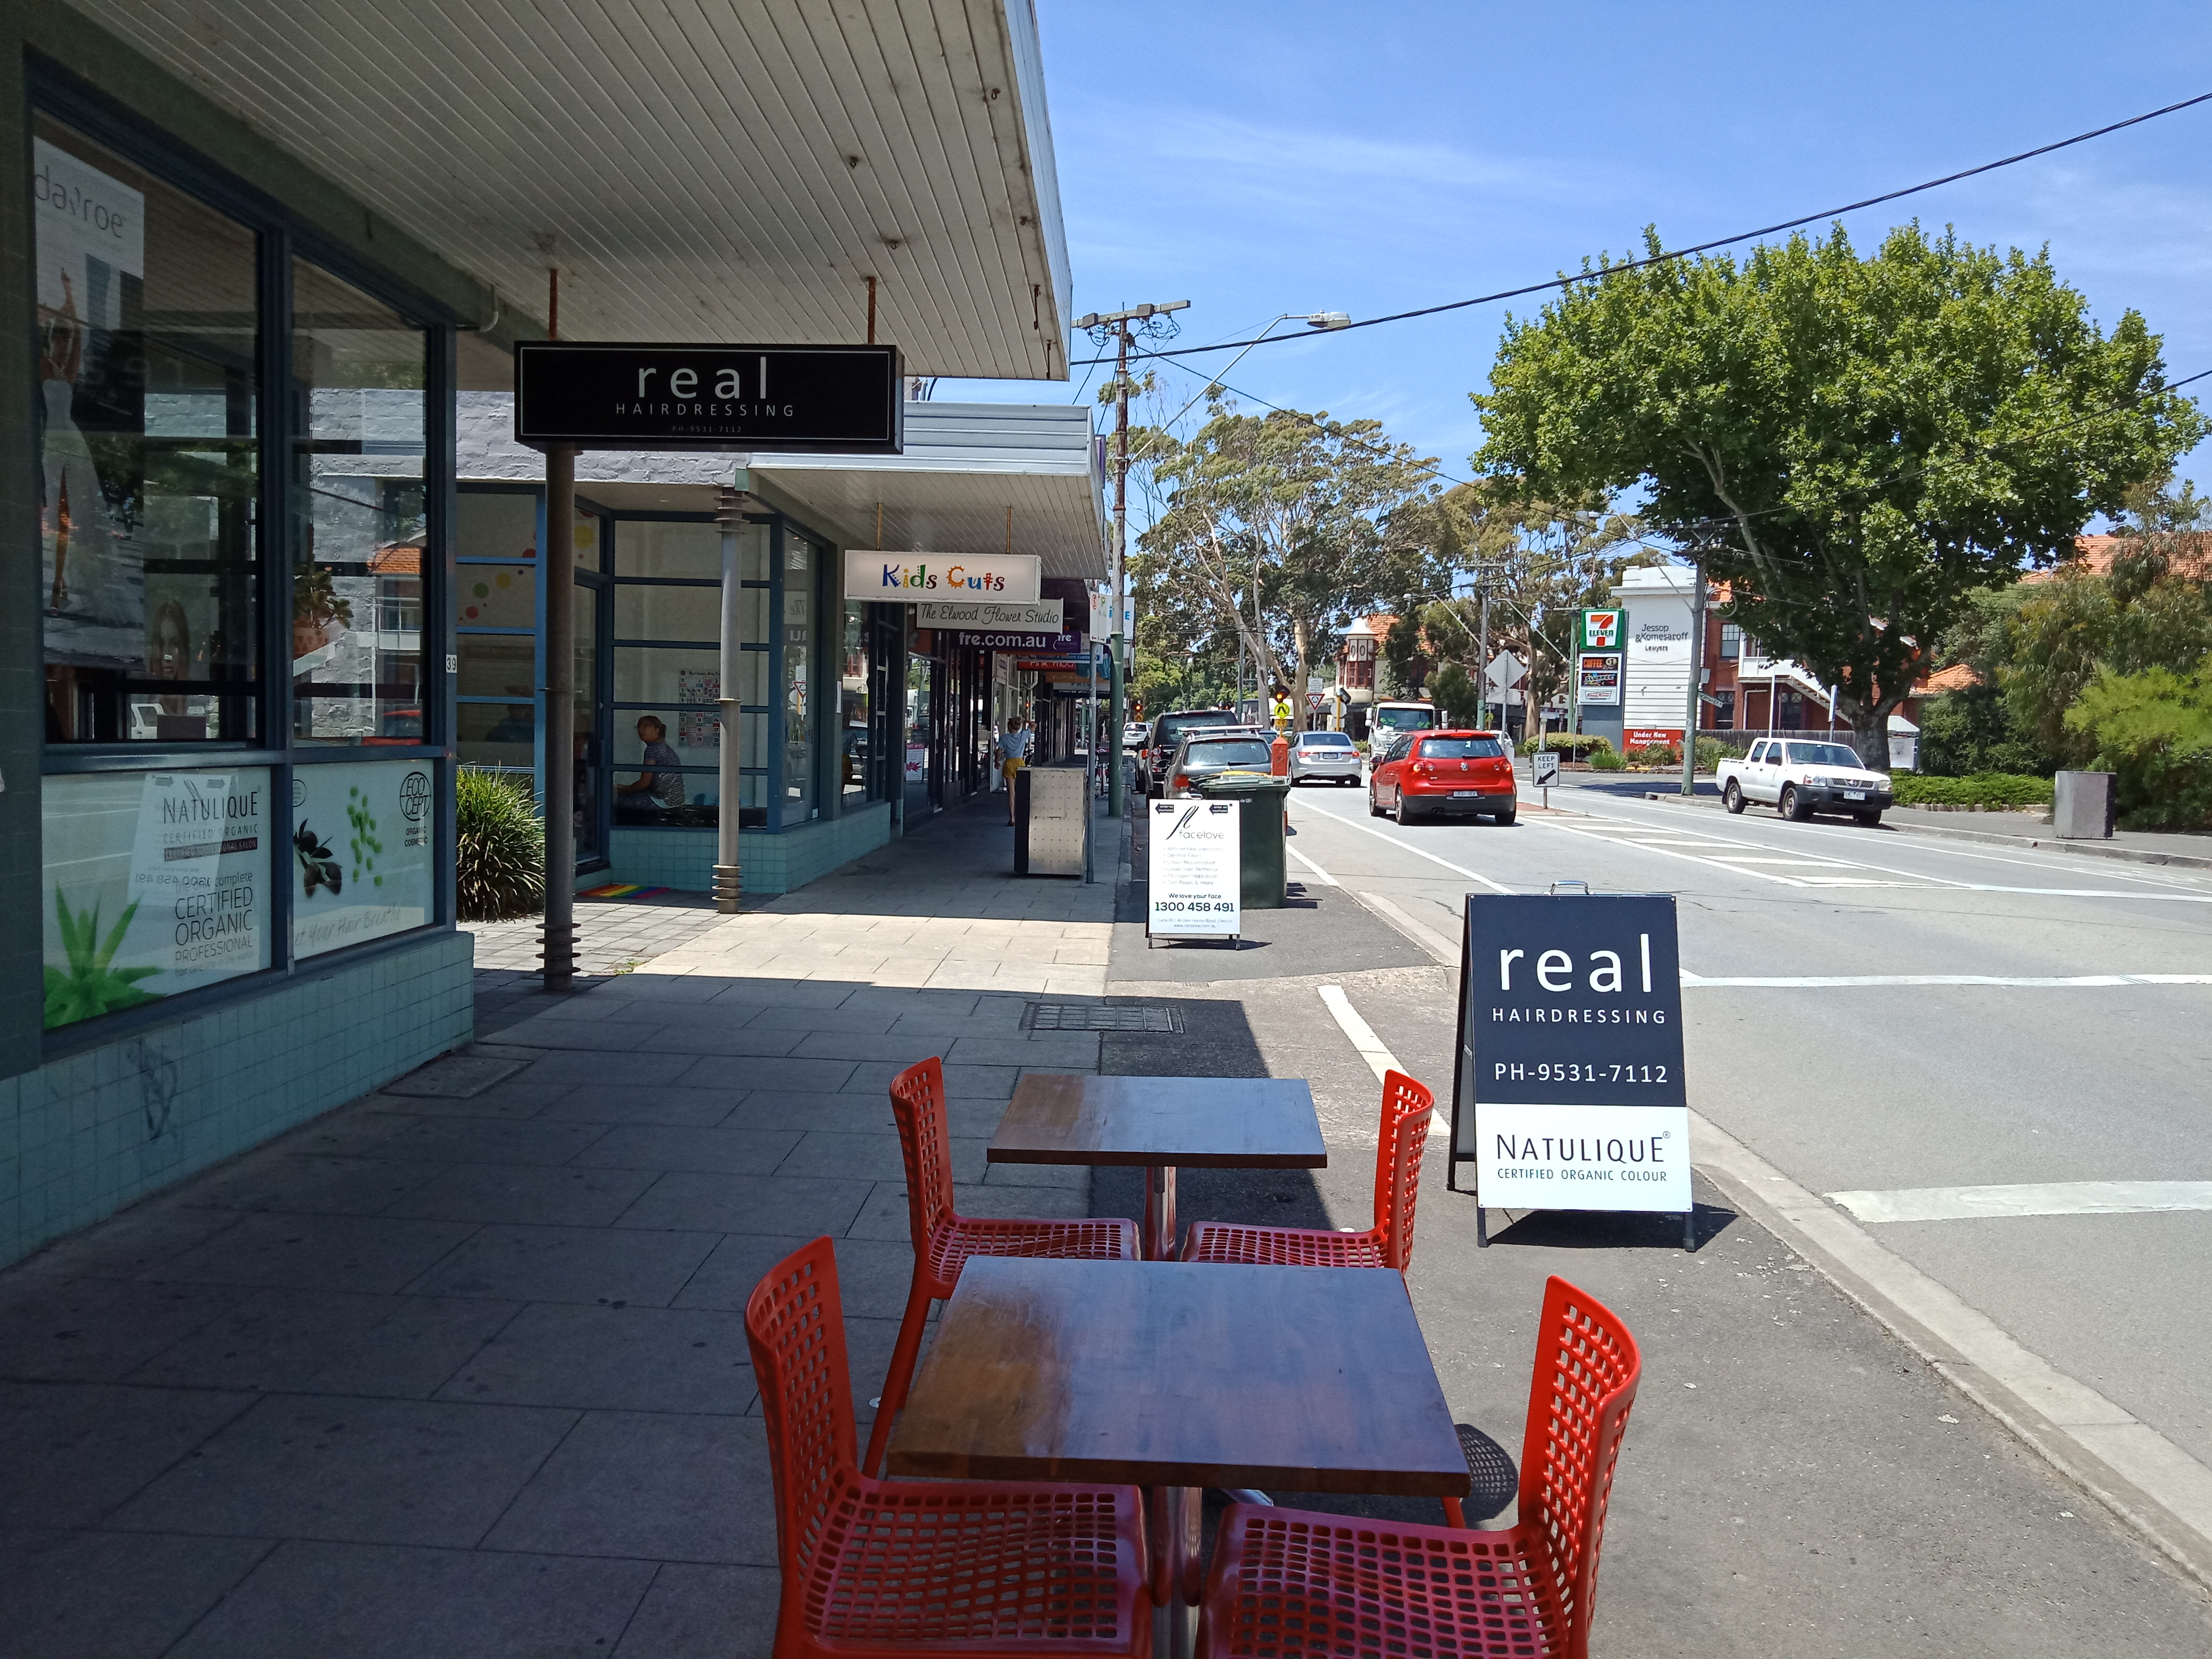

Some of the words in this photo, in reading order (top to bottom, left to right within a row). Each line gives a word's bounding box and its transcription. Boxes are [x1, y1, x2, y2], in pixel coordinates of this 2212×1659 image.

[639, 356, 767, 399] real
[616, 403, 793, 417] HAIRDRESSING
[882, 564, 937, 590] Kids
[946, 566, 1005, 591] Cuts
[921, 604, 936, 619] The
[941, 606, 979, 621] Elwood
[982, 606, 1021, 625] Flower
[1025, 610, 1059, 624] Studio
[1590, 614, 1614, 646] 7
[1641, 624, 1669, 633] Jessop
[959, 632, 1046, 648] fre.com.au
[447, 657, 456, 671] 39
[1583, 659, 1603, 668] COFFEE
[405, 777, 425, 797] ECO
[164, 791, 258, 824] NATULIQUE
[405, 794, 429, 816] CEPT
[164, 830, 213, 844] CERTIFIED
[219, 824, 258, 837] ORGANIC
[1179, 830, 1225, 839] facelove
[239, 840, 257, 850] SALON
[215, 872, 253, 887] complete
[175, 886, 253, 920] CERTIFIED
[1155, 902, 1185, 911] 1300
[1187, 902, 1211, 912] 458
[1214, 902, 1234, 912] 491
[175, 909, 253, 946] ORGANIC
[175, 935, 253, 964] PROFESSIONAL
[1500, 933, 1652, 993] real
[1492, 1008, 1665, 1024] HAIRDRESSING
[1495, 1062, 1668, 1083] PH-9531-7112
[1497, 1168, 1554, 1179] CERTIFIED
[1561, 1169, 1614, 1180] ORGANIC
[1621, 1170, 1667, 1182] COLOUR
